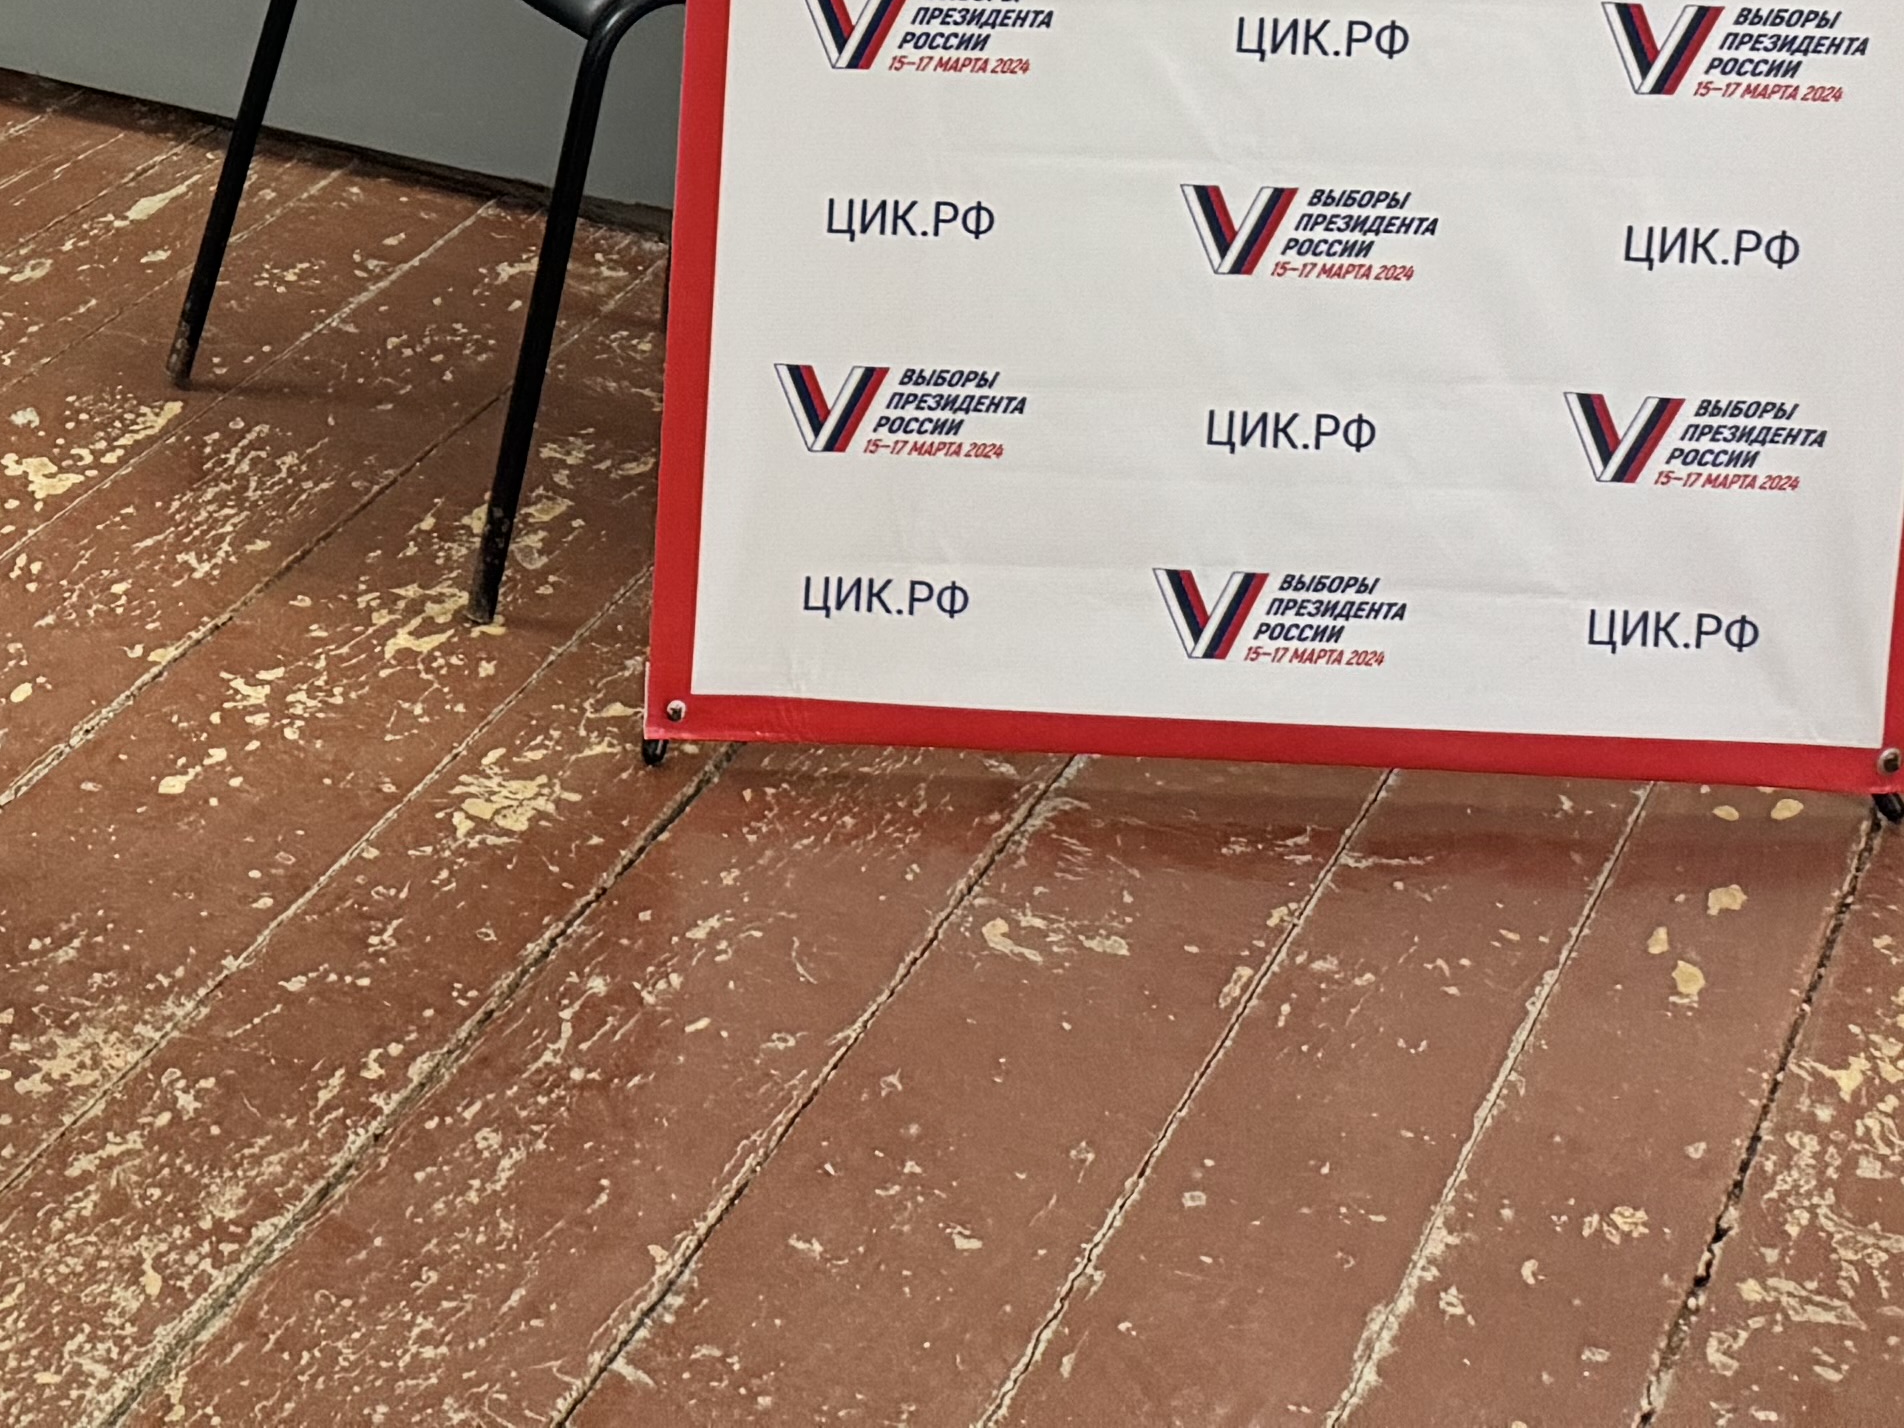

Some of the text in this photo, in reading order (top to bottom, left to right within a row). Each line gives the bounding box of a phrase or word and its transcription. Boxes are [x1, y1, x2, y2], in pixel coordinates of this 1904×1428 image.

[910, 7, 1054, 29] ПРЕЗИДЕНТА
[1733, 7, 1842, 29] ВЫБОРЫ
[897, 31, 991, 51] РОССИИ
[1236, 17, 1409, 62] ЦИК.РФ
[1718, 32, 1869, 56] ПРЕЗИДЕНТА
[933, 56, 989, 73] МАРТА
[990, 58, 1030, 74] 2024
[1704, 57, 1803, 79] РОССИИ
[1740, 83, 1800, 100] МАРТА
[1800, 85, 1843, 102] 2024
[1307, 189, 1412, 209] ВЫБОРЫ
[827, 198, 994, 242] ЦИК.РФ
[1294, 213, 1439, 236] ПРЕЗИДЕНТА
[1280, 238, 1375, 258] РОССИИ
[1624, 225, 1800, 271] ЦИК.РФ
[1316, 263, 1373, 280] МАРТА
[1374, 265, 1414, 281] 2024
[898, 368, 1000, 389] ВЫБОРЫ
[885, 392, 1027, 415] ПРЕЗИДЕНТА
[1694, 399, 1800, 420] ВЫБОРЫ
[873, 416, 965, 436] РОССИИ
[1207, 409, 1376, 454] ЦИК.РФ
[1679, 424, 1827, 448] ПРЕЗИДЕНТА
[907, 441, 963, 457] МАРТА
[963, 442, 1004, 459] 2024
[1665, 448, 1760, 468] РОССИИ
[1701, 473, 1758, 489] МАРТА
[1758, 475, 1800, 491] 2024
[1278, 574, 1381, 595] ВЫБОРЫ
[803, 576, 969, 619] ЦИК.РФ
[1265, 598, 1407, 621] ПРЕЗИДЕНТА
[1253, 622, 1345, 643] РОССИИ
[1588, 609, 1759, 654] ЦИК.РФ
[1289, 648, 1344, 665] МАРТА
[1345, 650, 1384, 667] 2024
